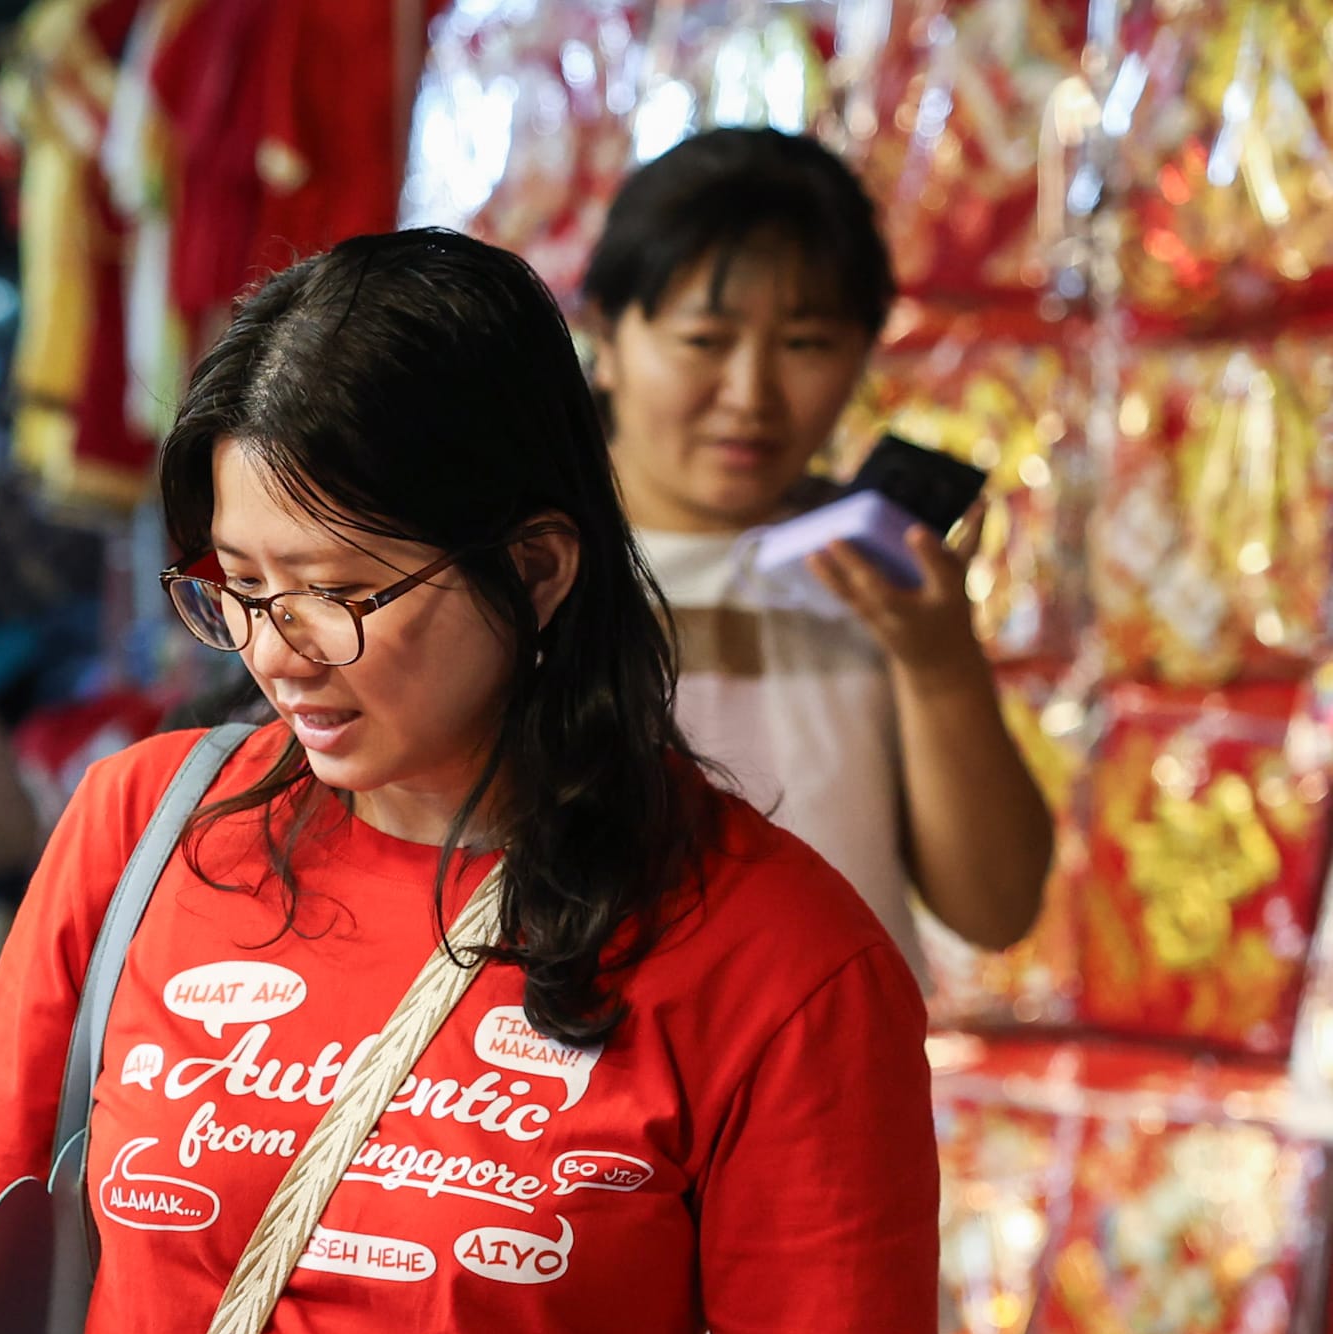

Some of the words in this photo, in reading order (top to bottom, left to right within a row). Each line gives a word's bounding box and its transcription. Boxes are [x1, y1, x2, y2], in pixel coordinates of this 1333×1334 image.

[174, 982, 245, 1004] HUAT
[252, 981, 302, 1003] AH!
[489, 1037, 582, 1067] MAKAN!!
[179, 1101, 296, 1168] from
[352, 1131, 548, 1199] ingapore
[563, 1160, 598, 1177] BO
[604, 1167, 642, 1184] JIO
[110, 1187, 201, 1217] ALAMAK...
[367, 1245, 426, 1272] HEHE
[463, 1234, 562, 1275] AIYO
